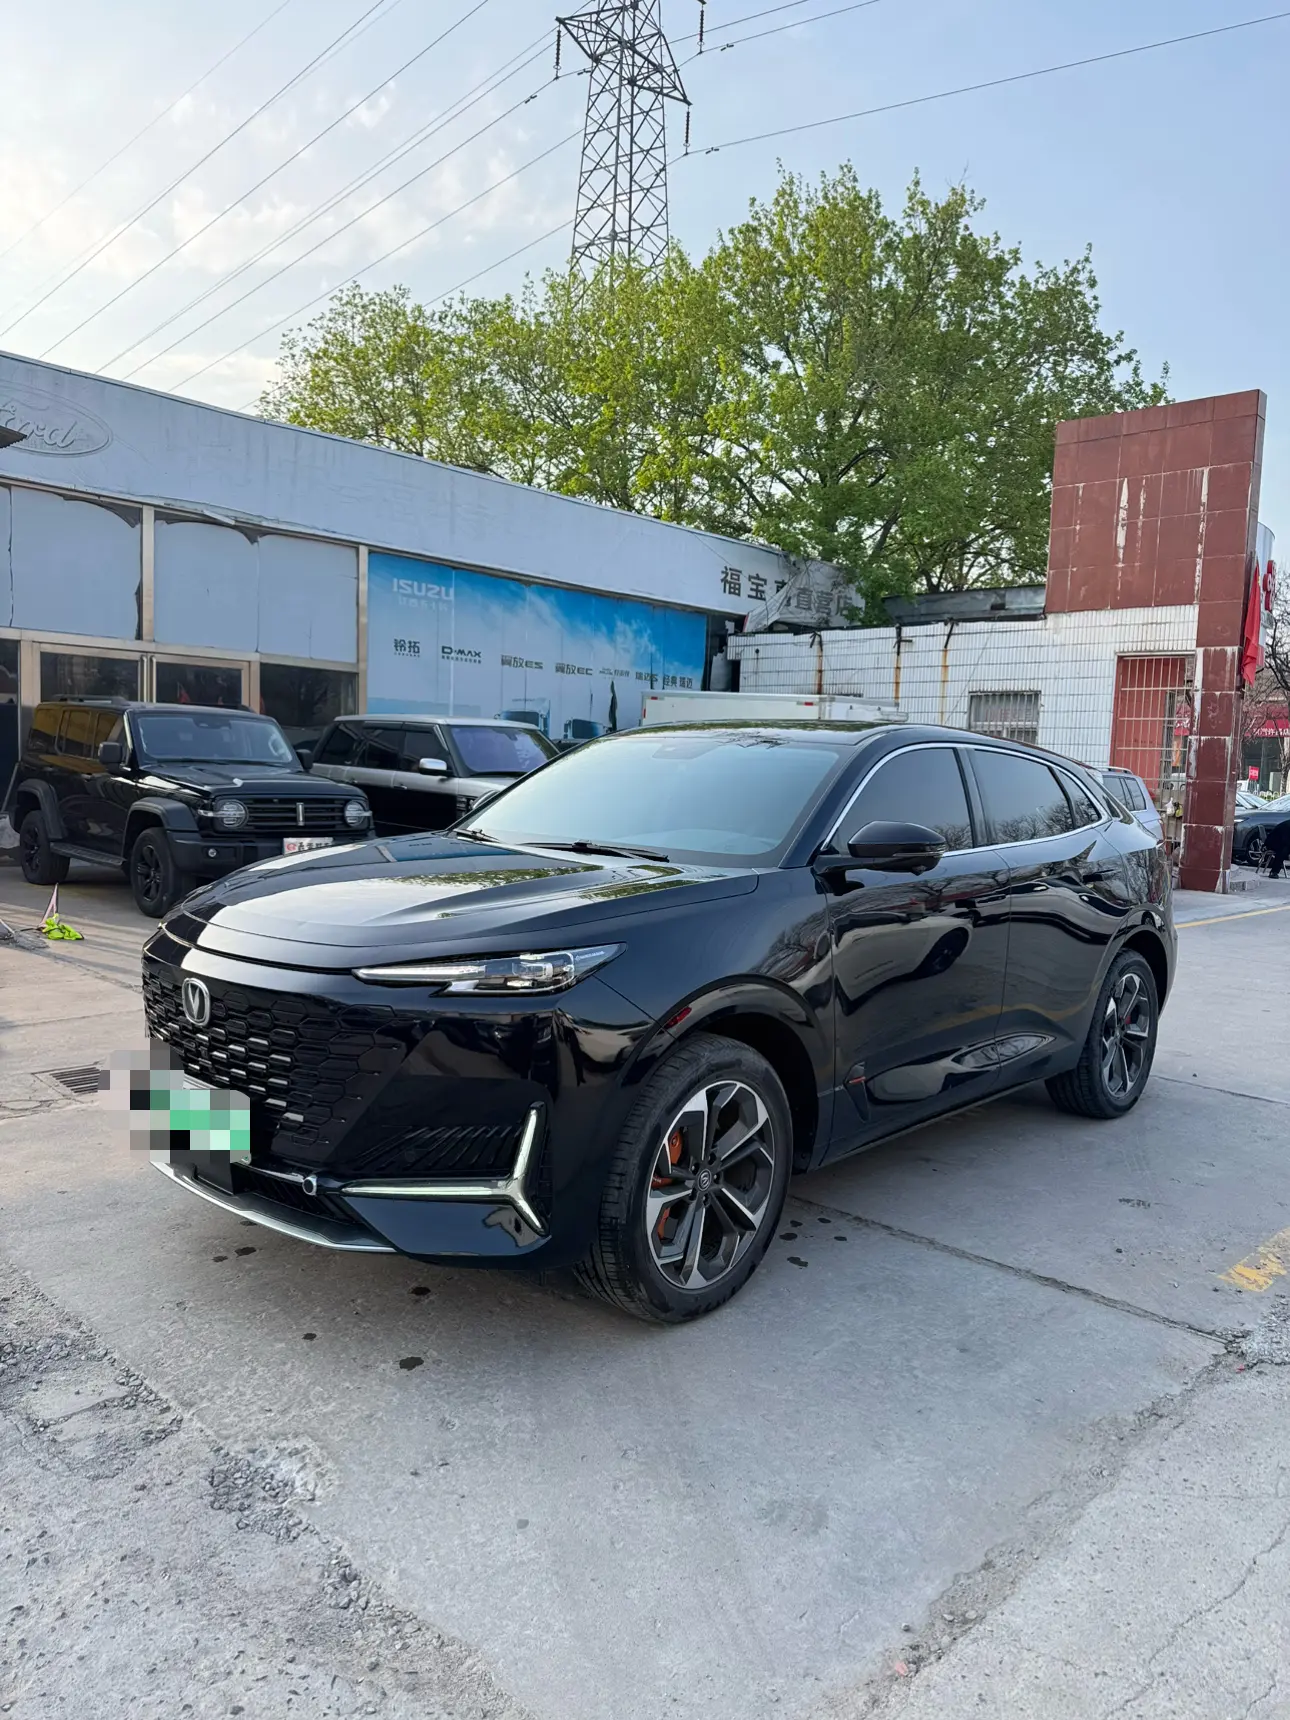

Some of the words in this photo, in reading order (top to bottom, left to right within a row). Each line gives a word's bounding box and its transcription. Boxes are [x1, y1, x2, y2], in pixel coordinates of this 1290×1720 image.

[393, 578, 454, 600] ISUZU
[720, 565, 853, 617] 福宝直营店
